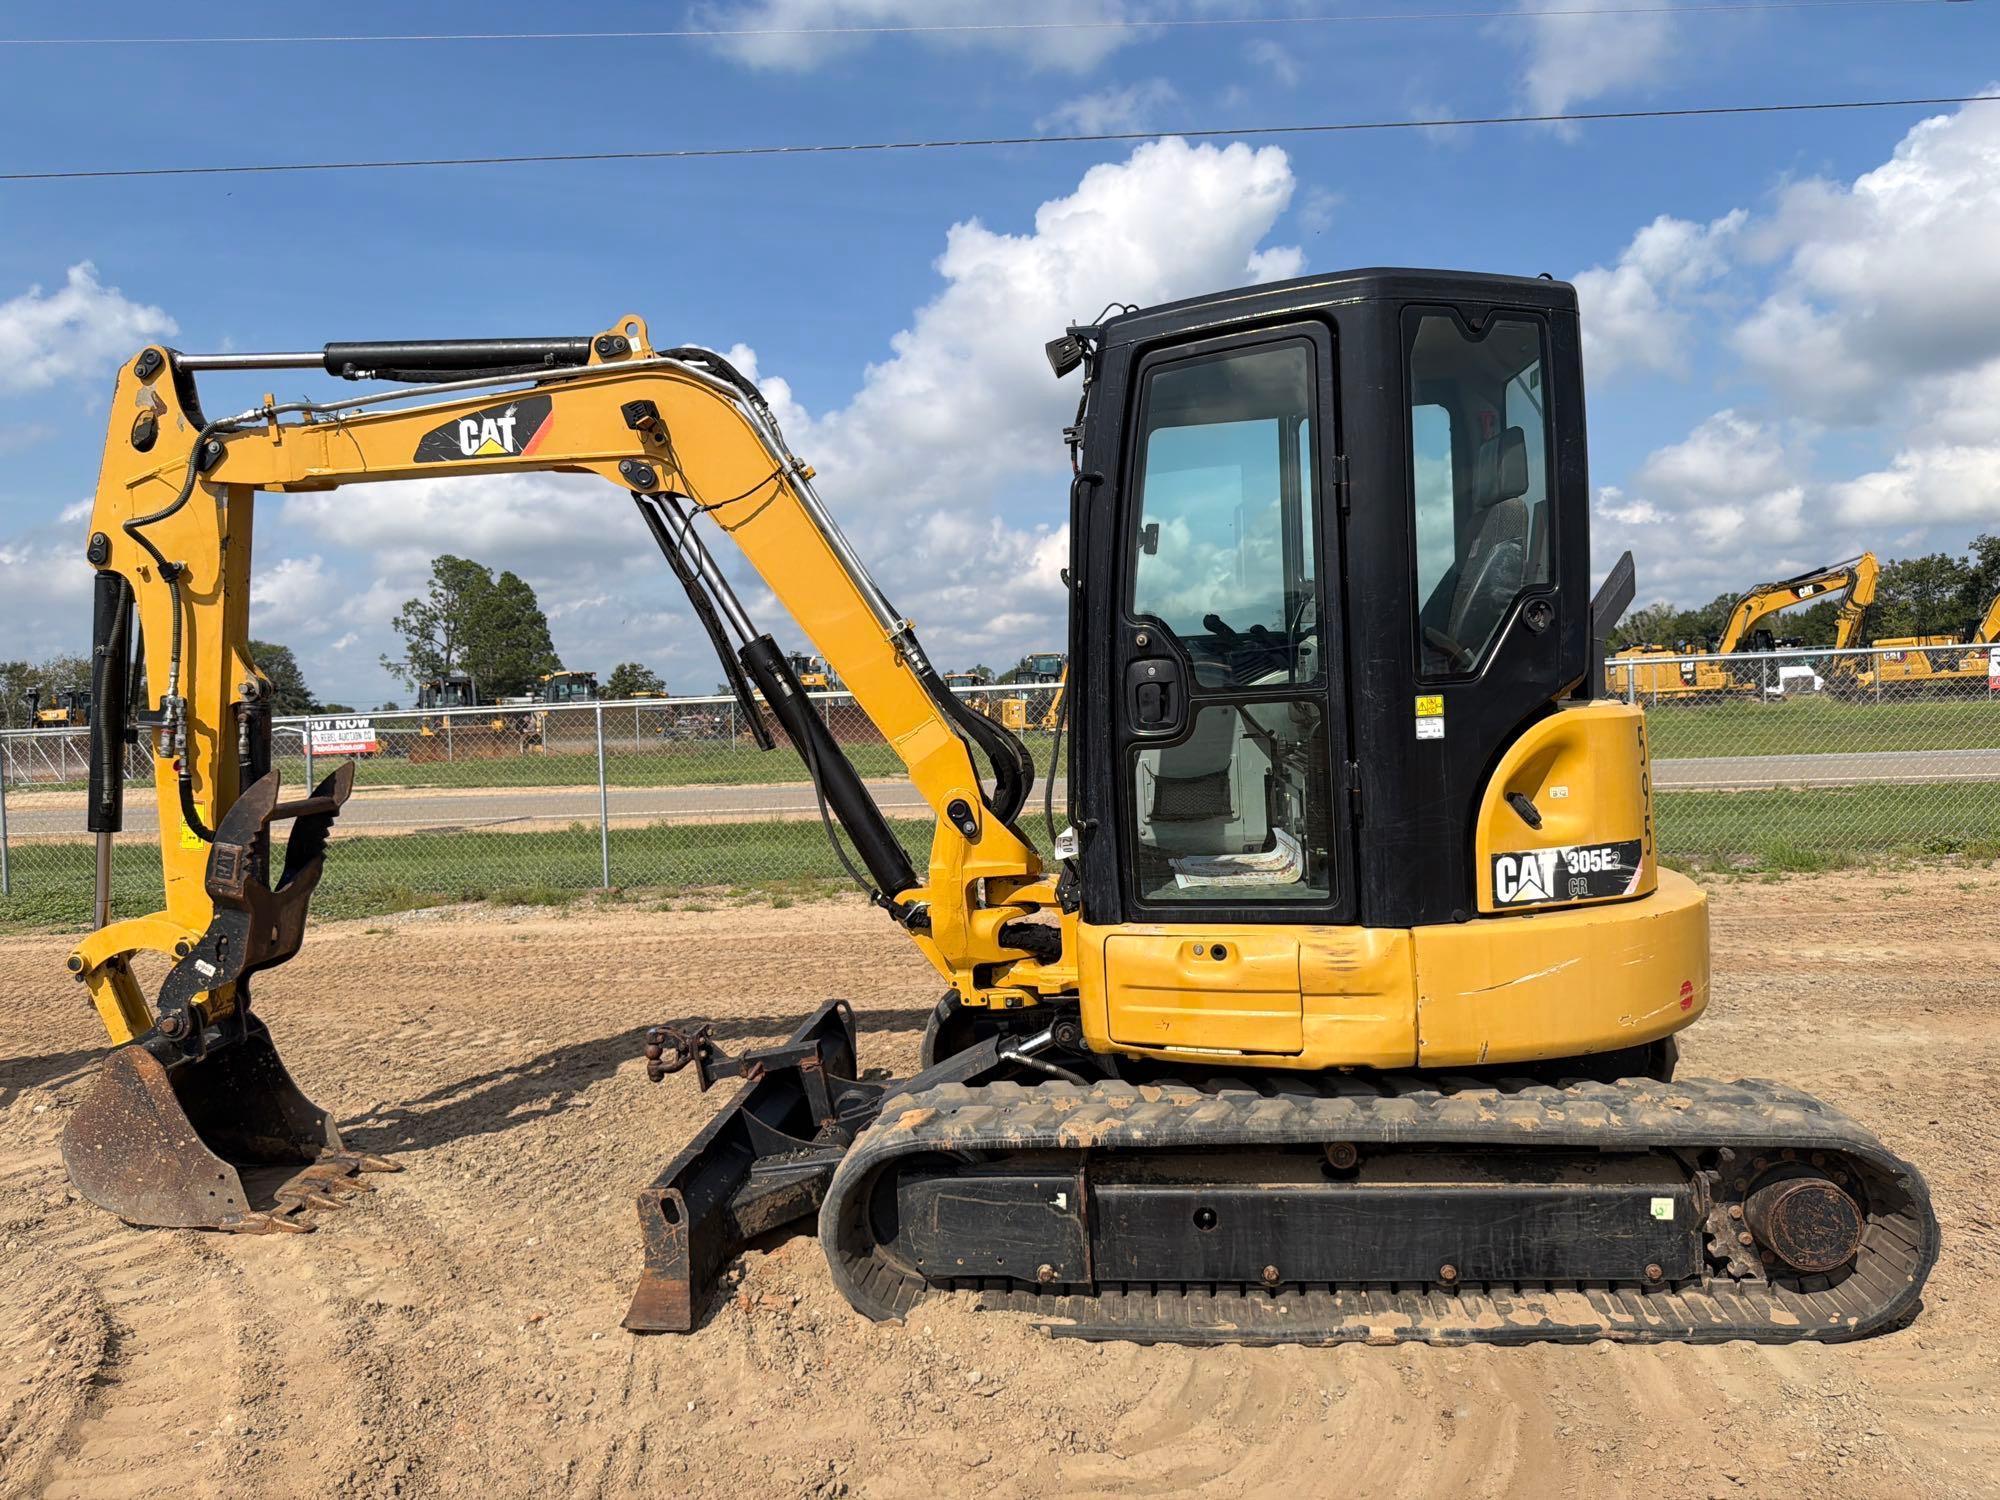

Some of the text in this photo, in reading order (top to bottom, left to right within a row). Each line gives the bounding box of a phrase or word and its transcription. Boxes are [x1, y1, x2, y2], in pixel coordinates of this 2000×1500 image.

[459, 417, 516, 456] CAT
[1798, 584, 1814, 598] CAT
[1680, 661, 1695, 672] CAT
[335, 719, 370, 730] NOW
[320, 733, 337, 743] REBEL
[1637, 725, 1652, 856] 595
[1062, 836, 1074, 853] 210
[1496, 847, 1621, 902] CAT 305E2
[1568, 877, 1588, 896] CR
